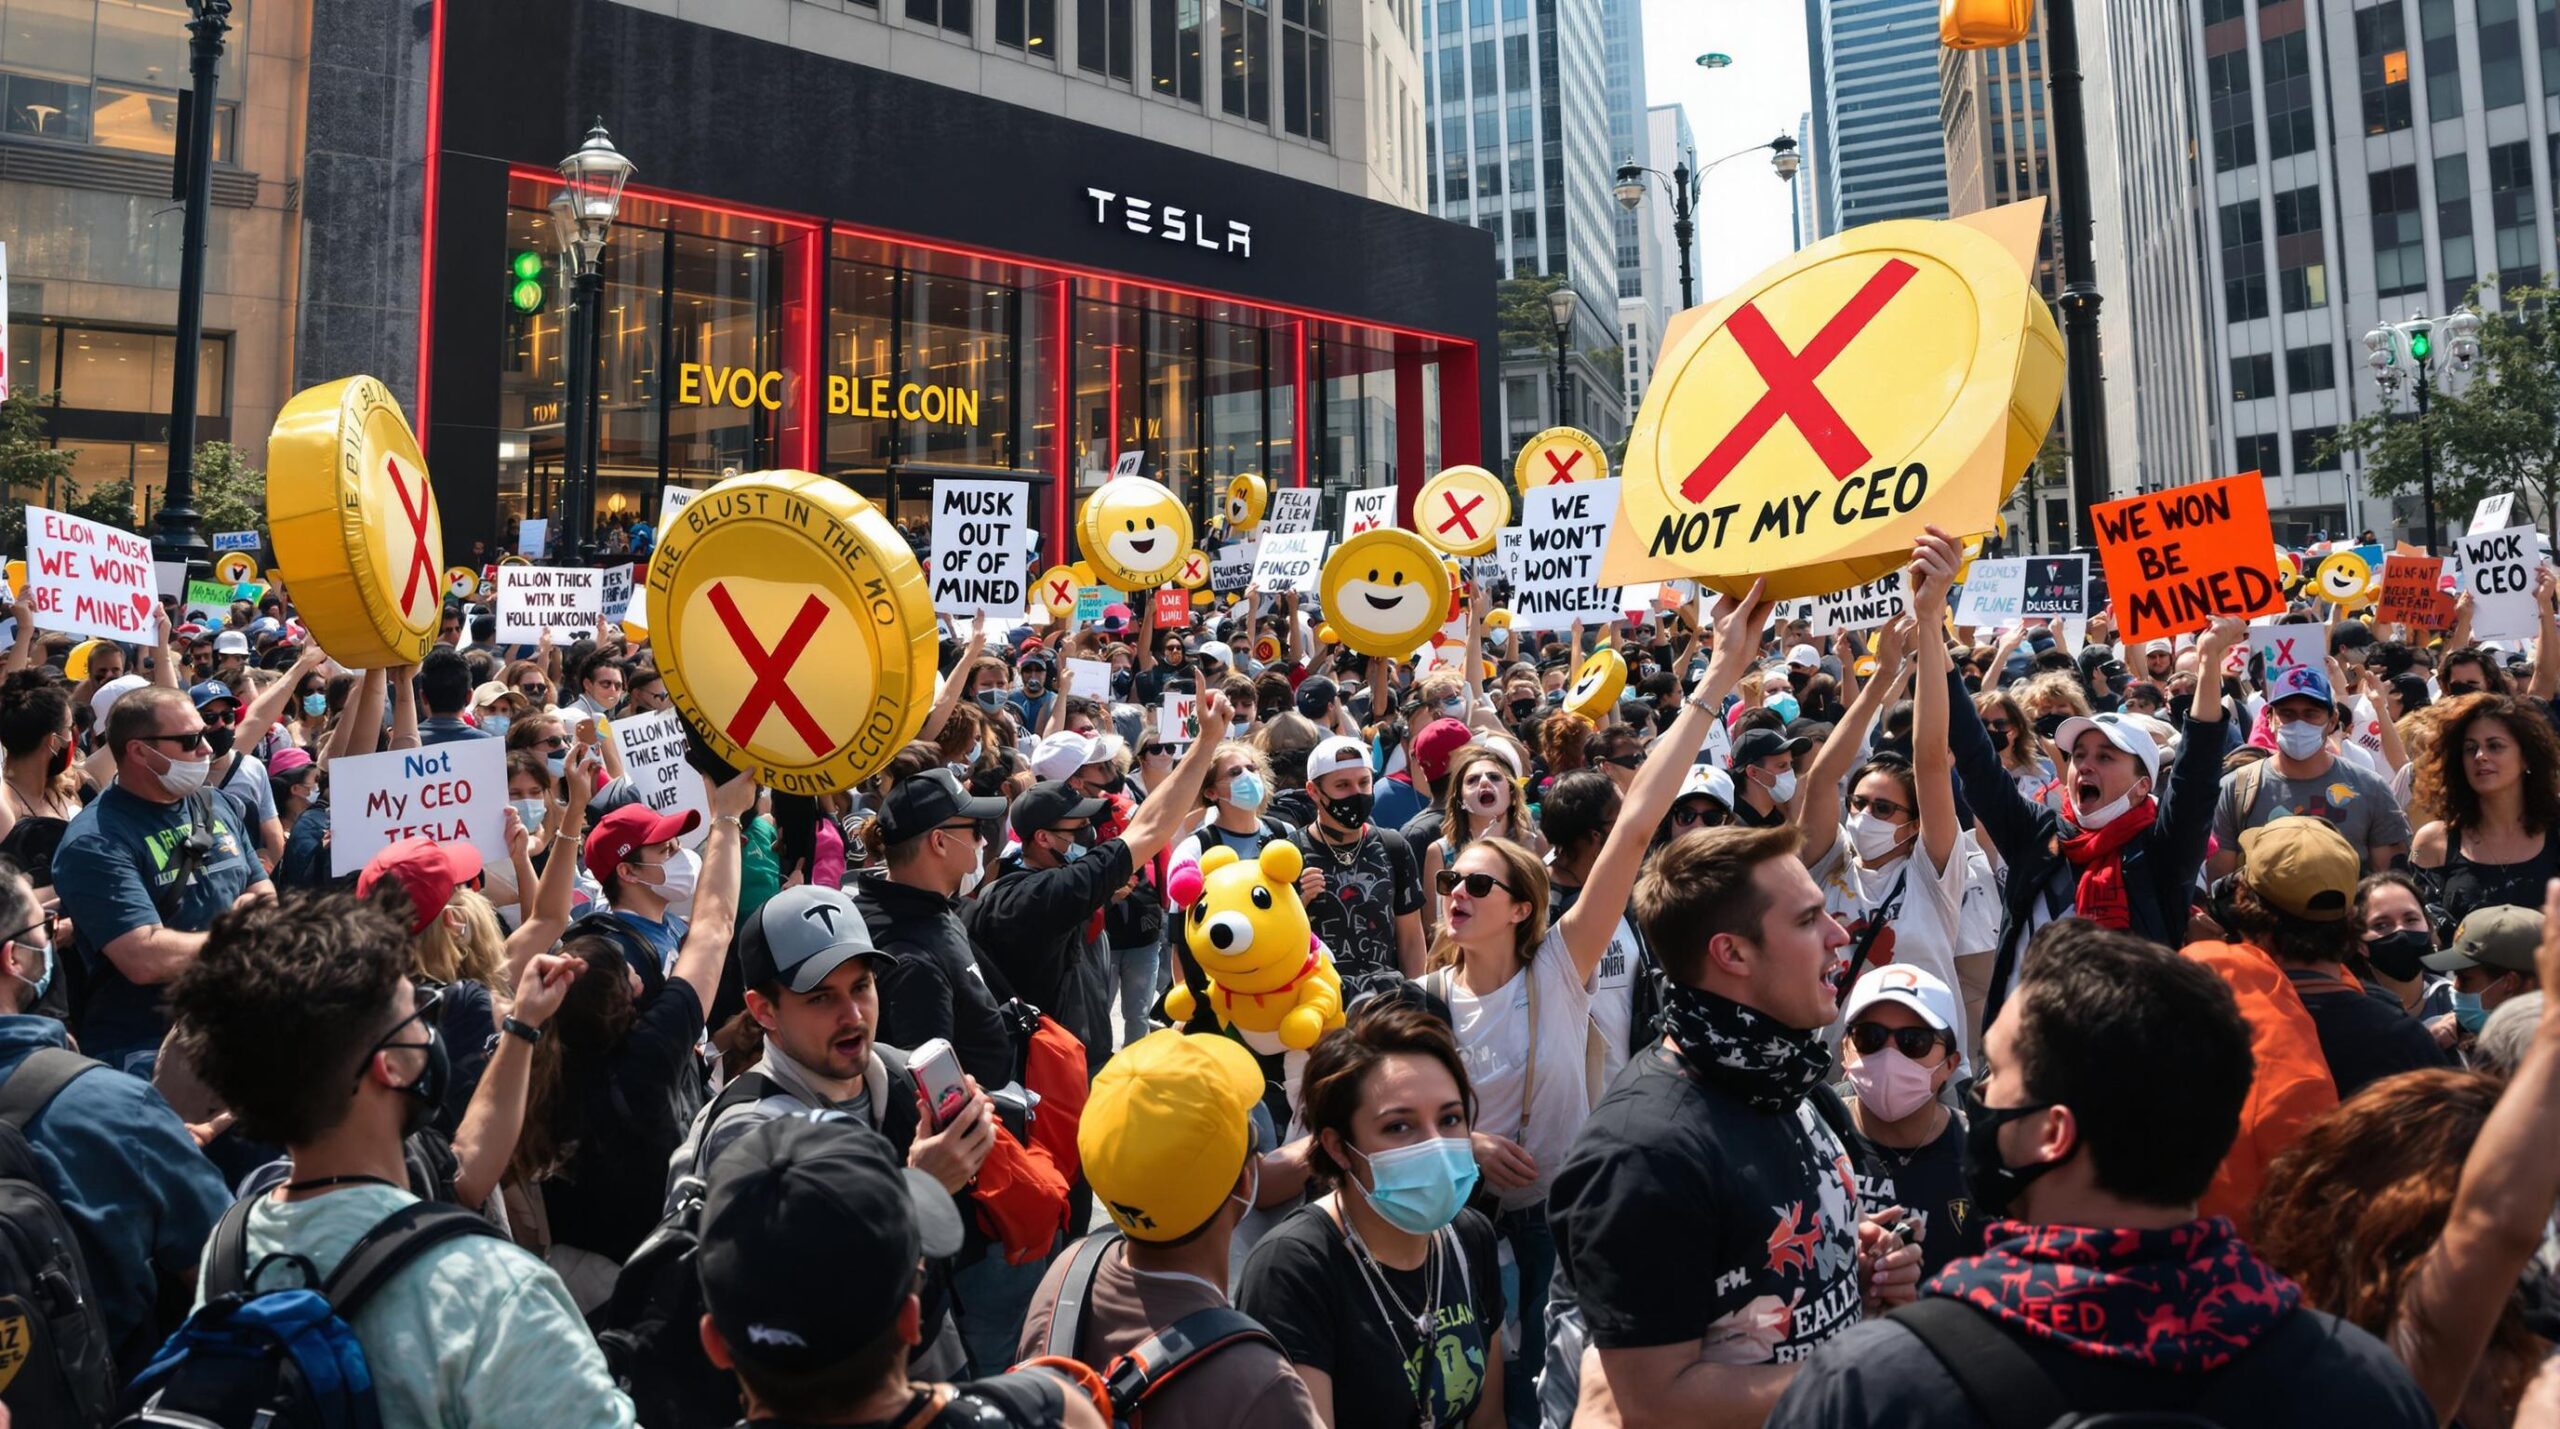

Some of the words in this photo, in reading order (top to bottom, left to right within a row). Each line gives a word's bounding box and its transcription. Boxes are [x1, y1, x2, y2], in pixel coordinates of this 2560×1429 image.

[1087, 187, 1251, 257] TESLA
[679, 363, 784, 411] EVOC
[943, 489, 1014, 516] MUSK
[1355, 495, 1386, 512] NOT
[1551, 494, 1590, 520] WE
[1648, 503, 1740, 558] NOT
[1749, 490, 1821, 543] MY
[1832, 462, 1928, 527] CEO
[2097, 502, 2152, 545] WE
[2156, 486, 2231, 531] WON
[687, 493, 769, 534] BLUST
[784, 498, 810, 528] IN
[823, 519, 867, 571] THE
[958, 522, 1012, 546] OUT
[1529, 524, 1607, 551] WON'T
[107, 533, 150, 564] MUSK
[943, 550, 972, 572] OF
[977, 552, 1010, 574] OF
[2137, 542, 2190, 581] BE
[37, 547, 80, 578] WE
[90, 555, 147, 588] WONT
[556, 573, 592, 587] THICK
[1525, 555, 1592, 582] WON'T
[2475, 564, 2527, 595] CEO
[36, 587, 64, 613] BE
[935, 578, 1019, 604] MINED
[1517, 586, 1624, 614] MINGE!!!
[405, 751, 451, 778] Not
[657, 763, 679, 784] OFF
[366, 789, 408, 821] My
[421, 780, 472, 809] CEO
[384, 819, 470, 844] TESLA
